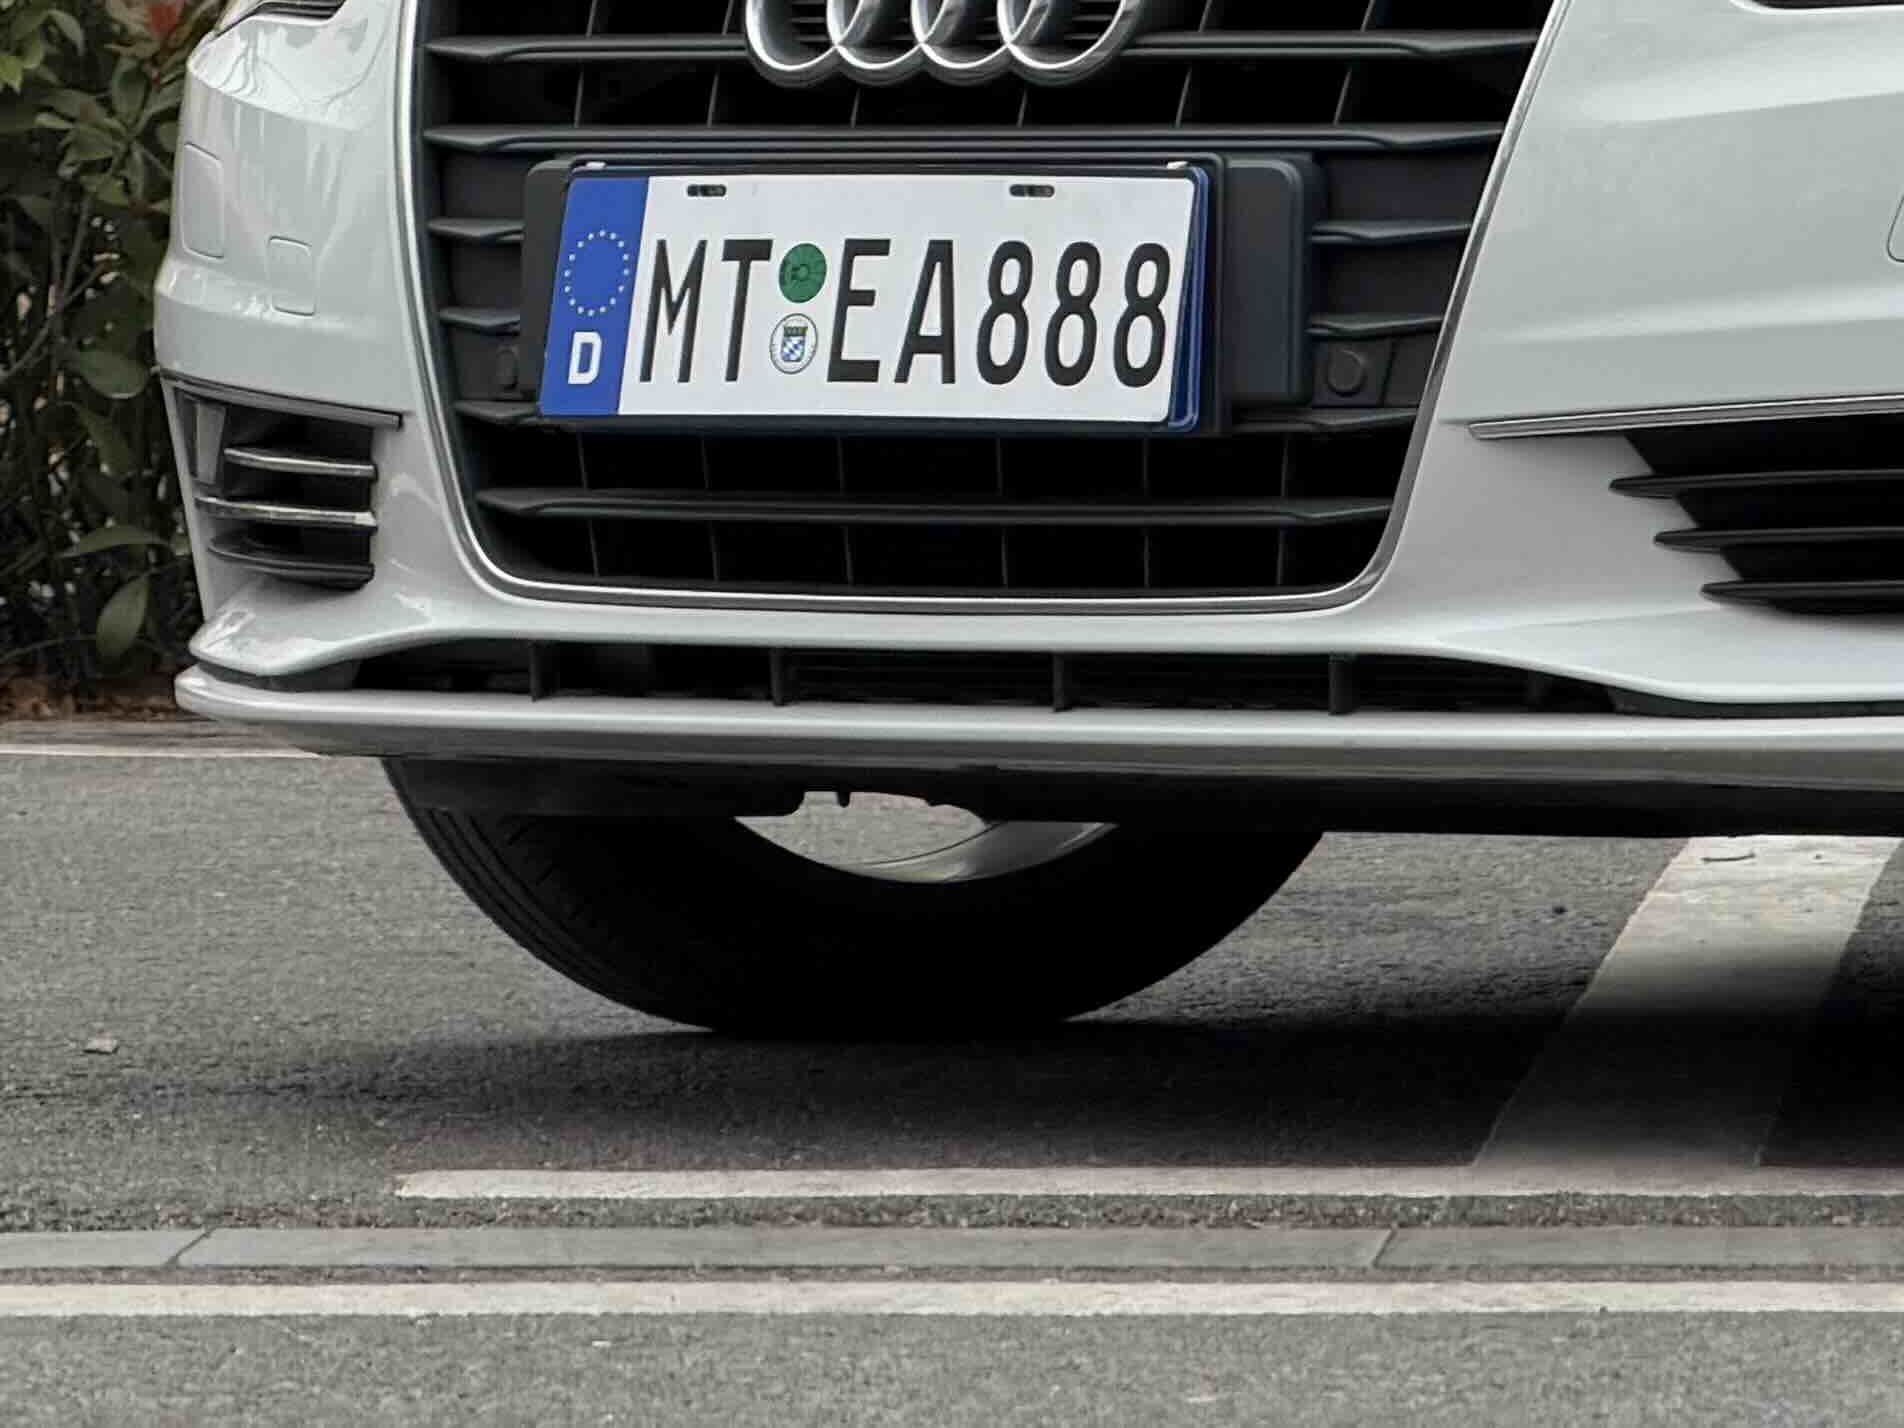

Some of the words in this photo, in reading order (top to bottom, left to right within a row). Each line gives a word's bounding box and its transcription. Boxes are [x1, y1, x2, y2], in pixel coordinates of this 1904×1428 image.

[567, 330, 602, 385] D
[639, 239, 773, 384] MT
[826, 238, 1171, 387] EA888
